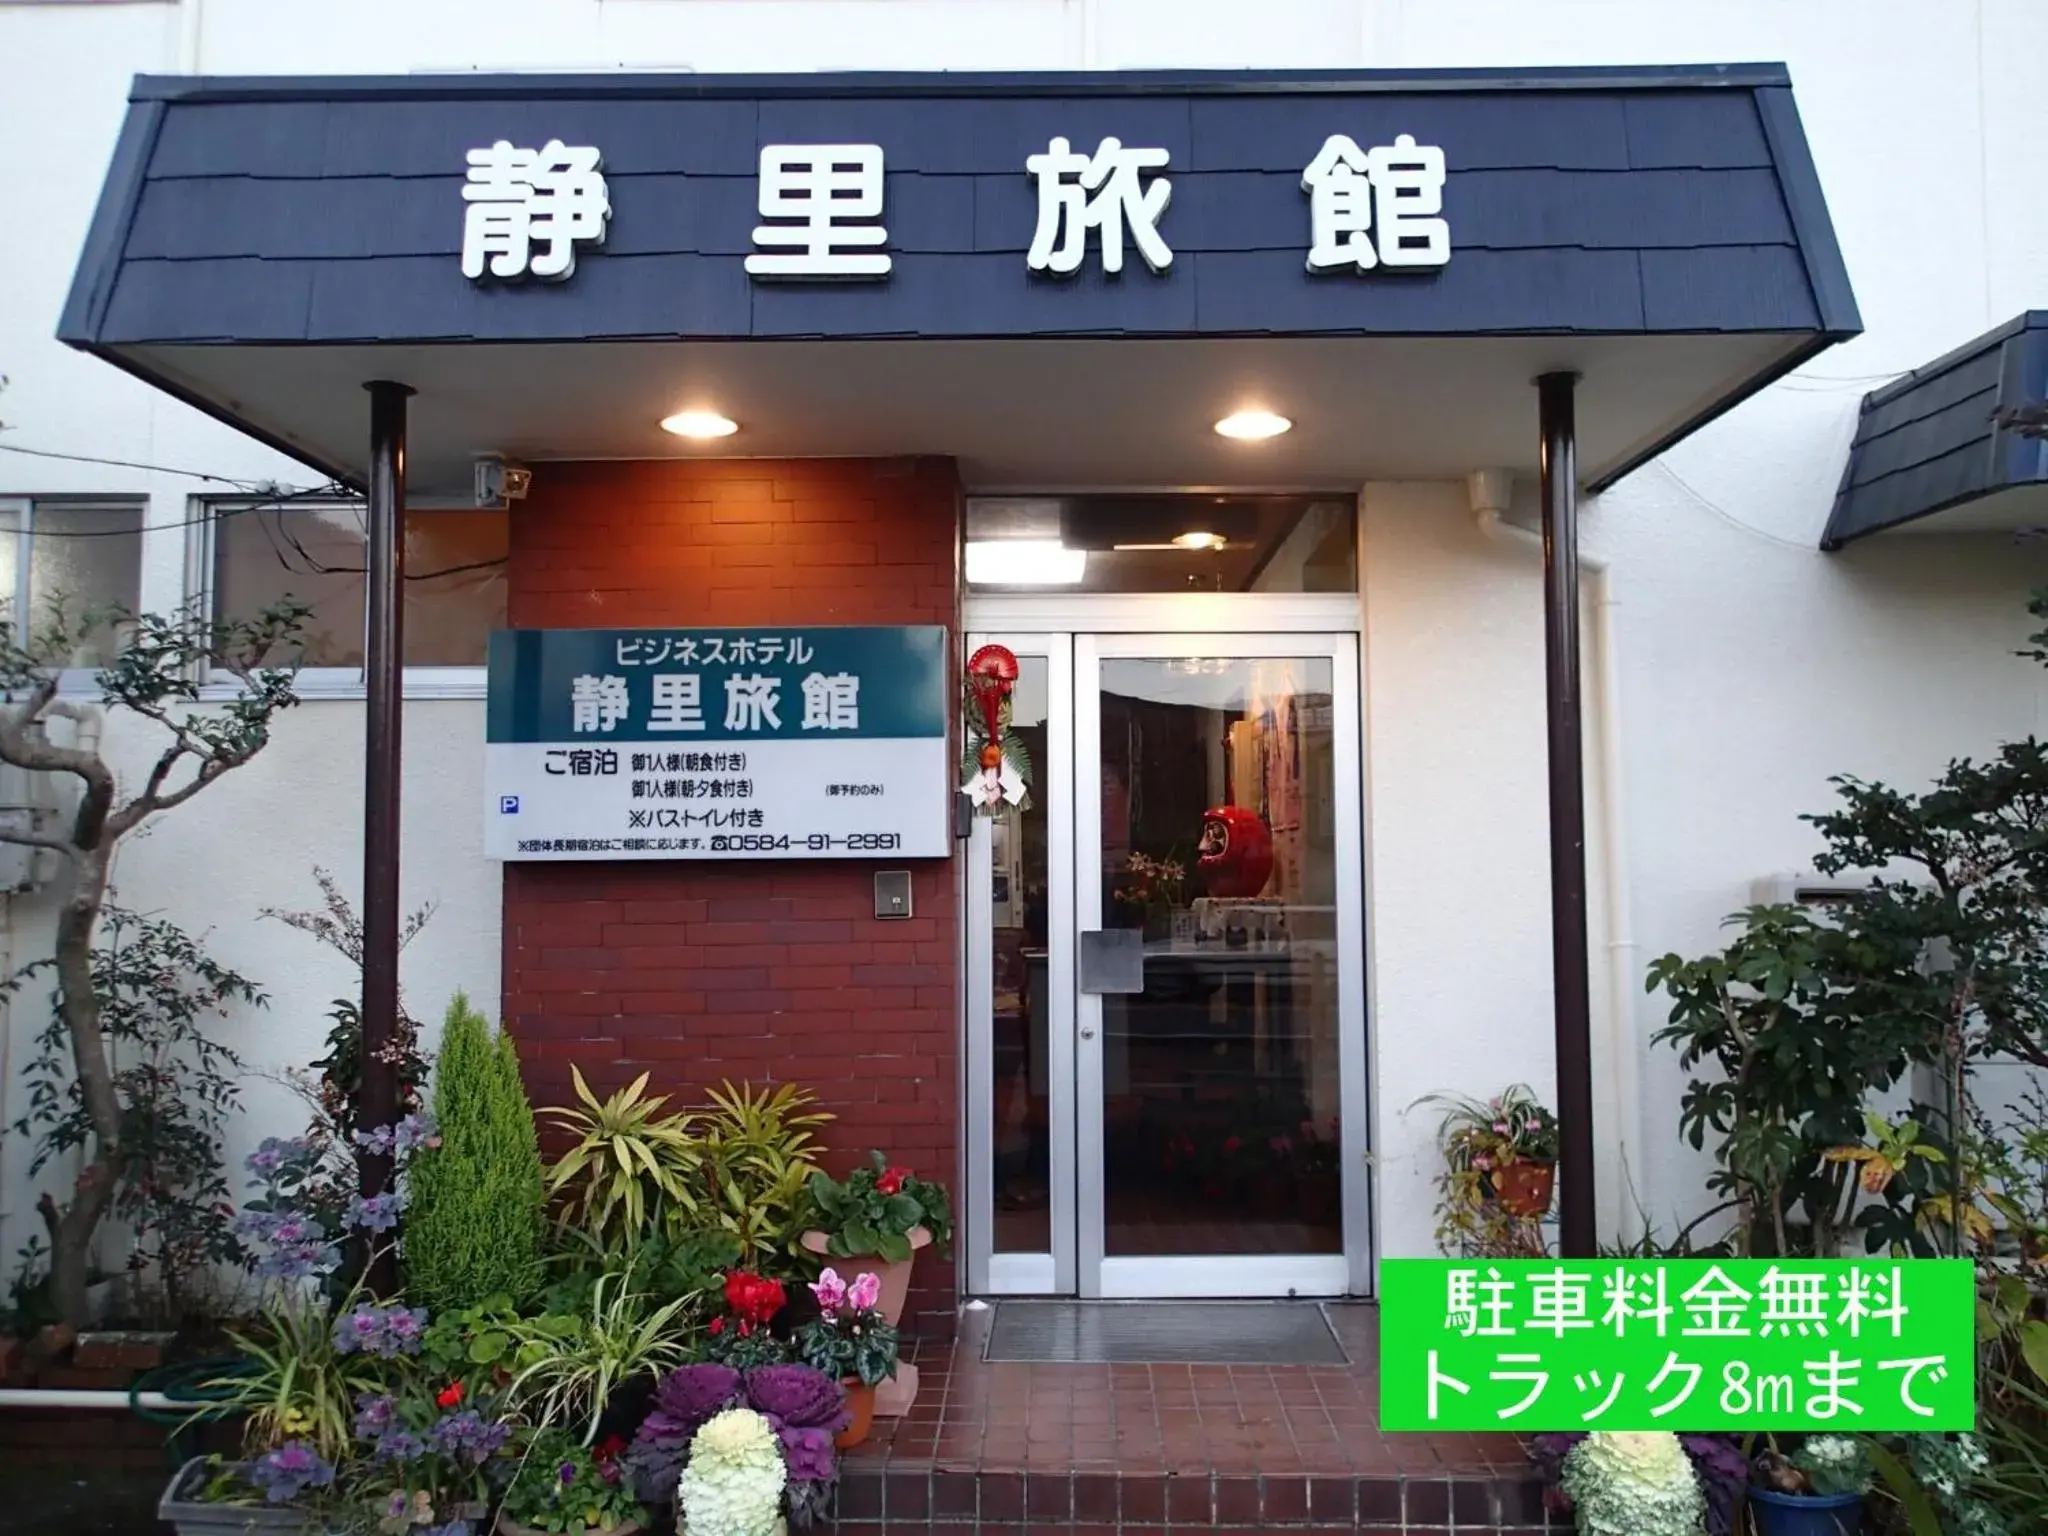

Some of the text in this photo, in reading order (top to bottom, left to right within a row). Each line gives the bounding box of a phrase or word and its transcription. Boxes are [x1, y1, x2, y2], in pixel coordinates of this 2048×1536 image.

[461, 133, 1451, 281] 静里旅館
[615, 637, 814, 666] ビジネスホテル
[571, 672, 860, 733] 静里旅館
[545, 749, 618, 776] ご宿泊
